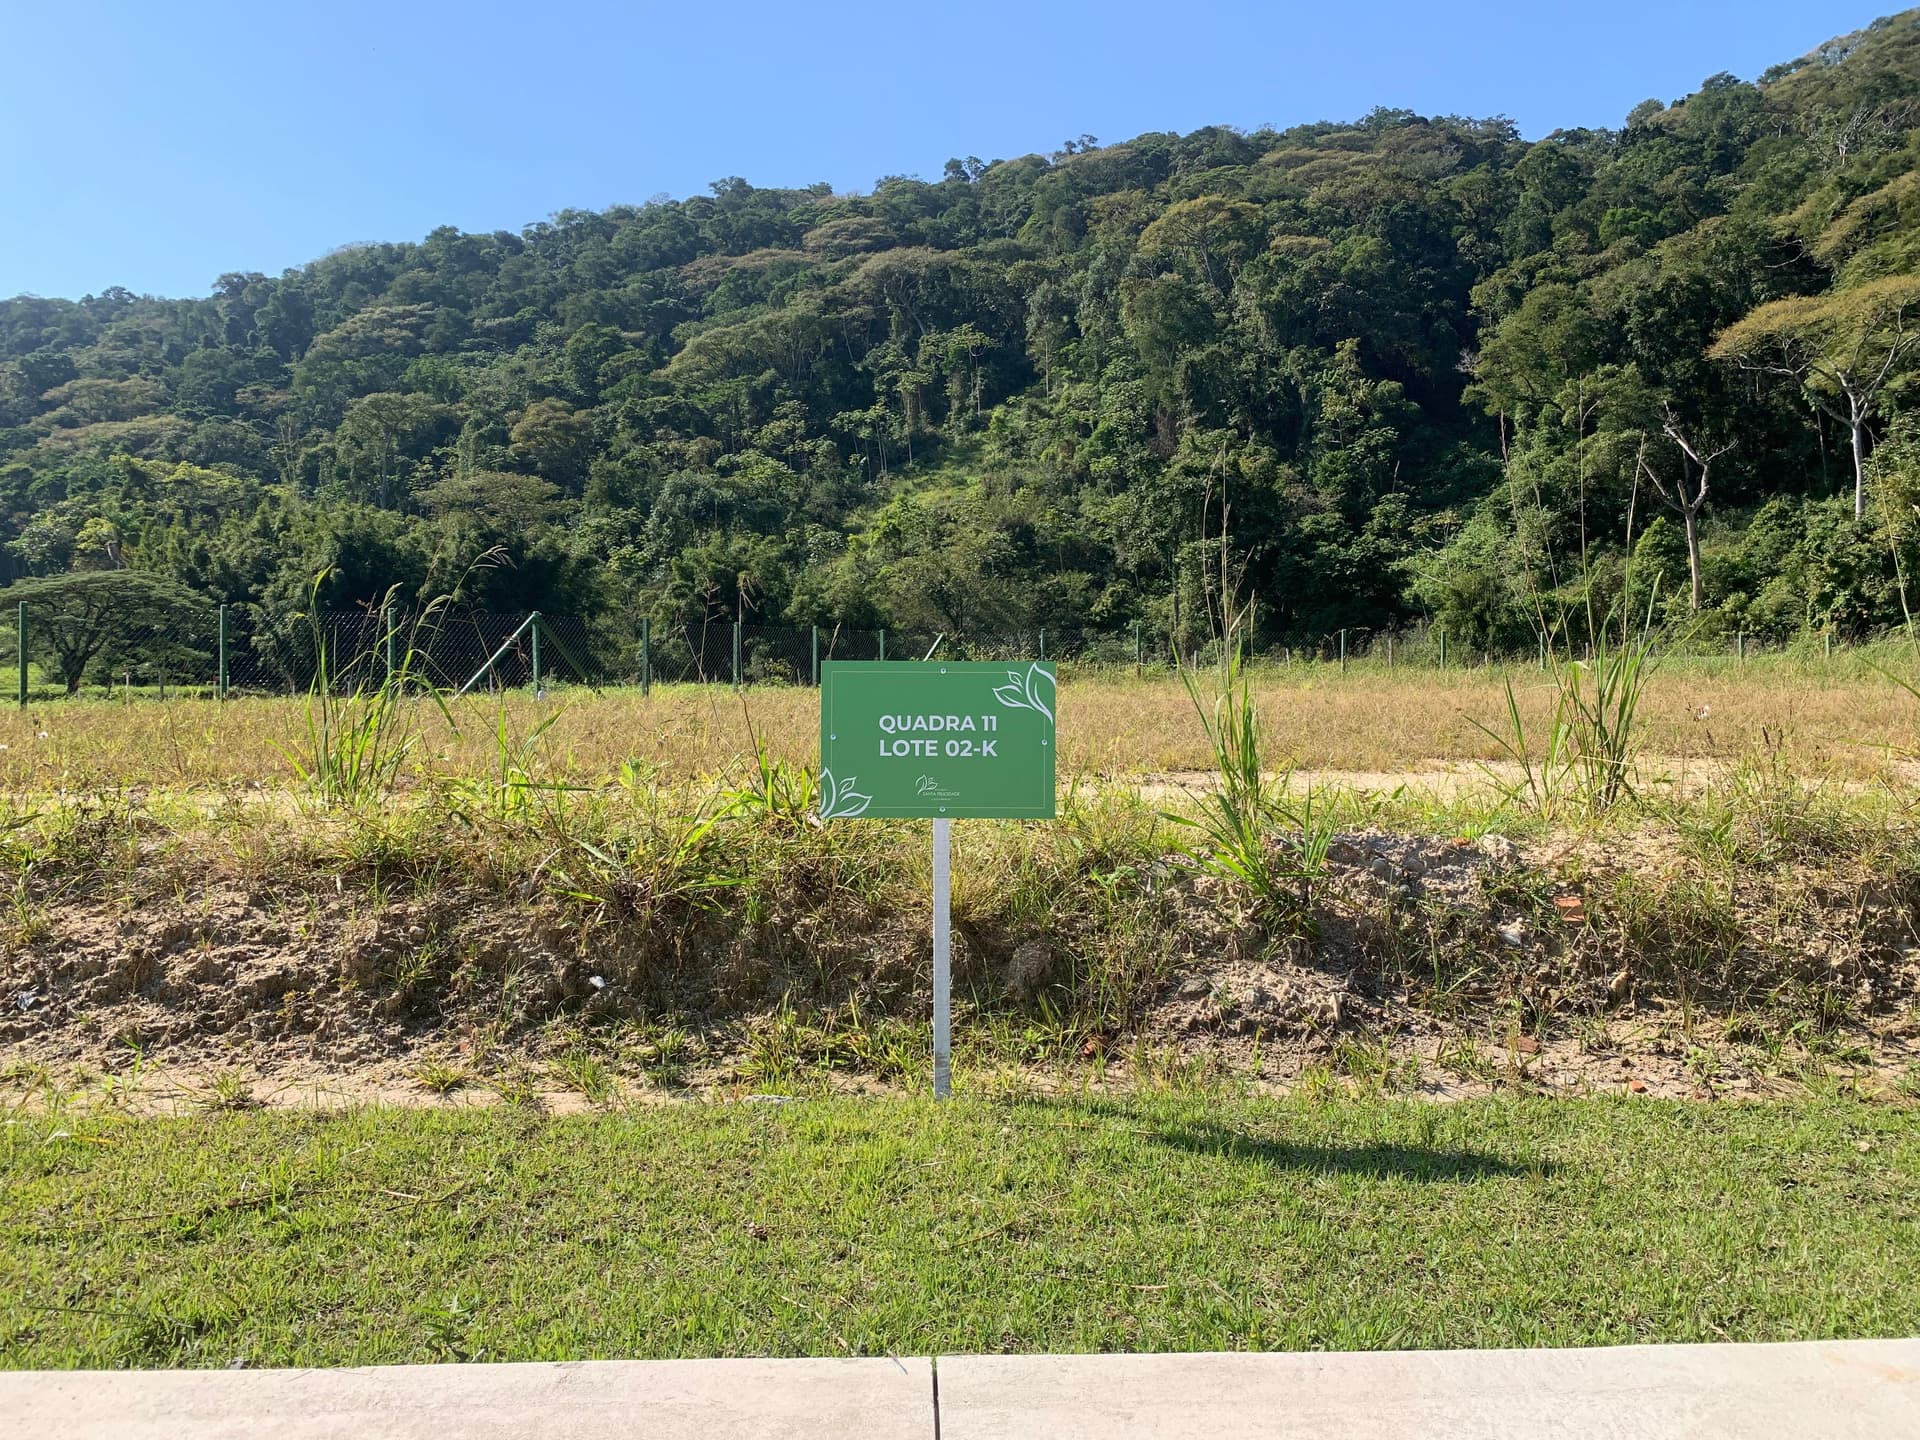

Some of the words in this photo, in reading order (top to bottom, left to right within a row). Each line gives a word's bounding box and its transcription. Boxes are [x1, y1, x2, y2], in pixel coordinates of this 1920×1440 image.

[879, 715, 976, 734] QUADRA
[981, 715, 997, 731] 11
[879, 739, 938, 757] LOTE
[945, 739, 998, 757] 02-K
